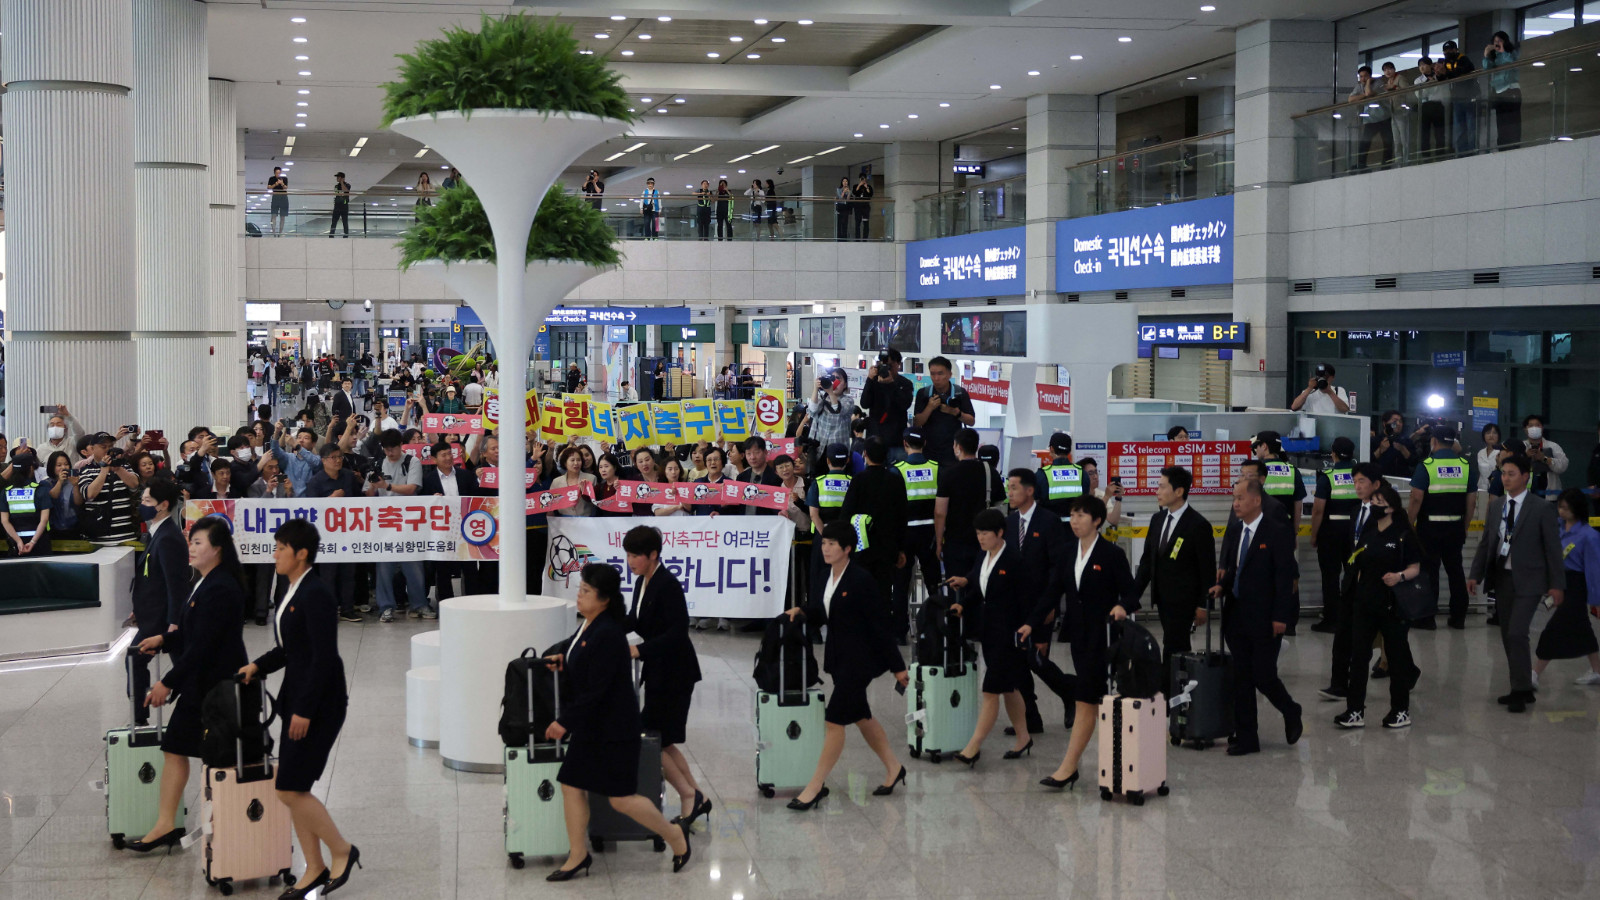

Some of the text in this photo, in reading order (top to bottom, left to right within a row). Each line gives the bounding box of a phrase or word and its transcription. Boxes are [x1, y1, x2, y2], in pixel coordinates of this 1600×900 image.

[1073, 236, 1103, 253] Domestic
[1108, 233, 1165, 267] 국내선수속
[919, 255, 941, 269] Domestic
[942, 254, 982, 281] 국내선수속
[1073, 257, 1102, 274] Check-in
[919, 273, 940, 286] Check-in
[589, 311, 625, 321] 국내선수속
[453, 323, 462, 333] B
[1212, 325, 1239, 340] B-F
[1121, 443, 1237, 455] SK telecom eSIM SIM
[325, 506, 373, 533] 여자
[377, 505, 452, 532] 축구단
[469, 519, 487, 537] 영
[723, 530, 770, 548] 여러분
